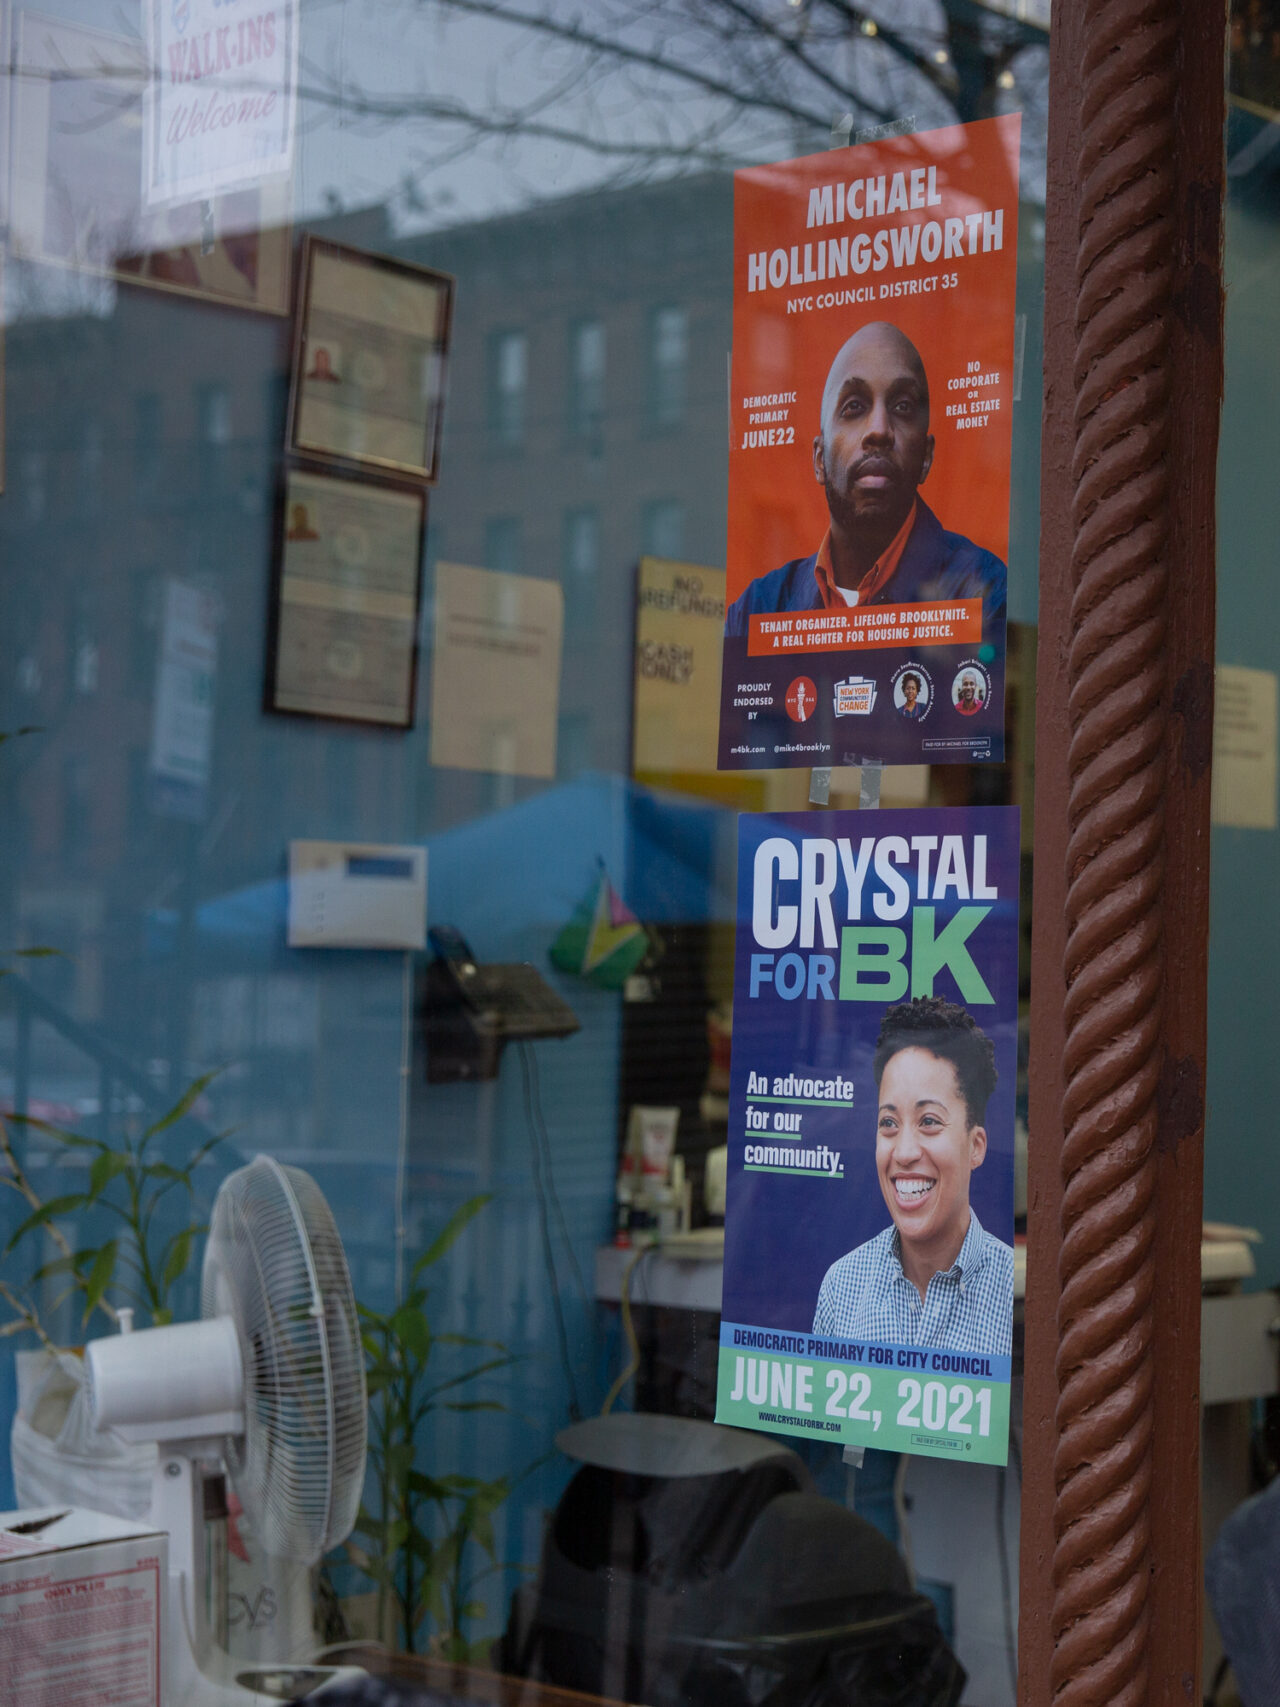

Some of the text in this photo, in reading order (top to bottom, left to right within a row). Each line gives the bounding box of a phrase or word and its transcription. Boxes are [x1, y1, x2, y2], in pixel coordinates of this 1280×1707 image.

[168, 11, 276, 84] WALK-INS
[166, 90, 277, 145] Welcome
[806, 165, 942, 229] MICHAEL
[748, 208, 1004, 293] HOLLINGSWORTH
[787, 273, 959, 314] NYC COUNCIL DISTRICT 35
[967, 361, 980, 373] NO
[947, 373, 1000, 391] CORPORATE
[743, 392, 797, 409] DEMOCRATIC
[967, 390, 979, 399] OR
[749, 410, 789, 424] PRIMARY
[946, 399, 1001, 416] REAL ESTATE
[956, 415, 989, 430] MONEY
[760, 607, 970, 634] TENANT ORGANIZER. LIFELONG BROOKLYNITE.
[773, 624, 955, 648] A REAL FIGHTER FOR HOUSING JUSTICE.
[737, 683, 772, 693] PROUDLY
[733, 697, 774, 707] ENDORSED
[839, 701, 869, 711] CHANGE
[748, 712, 758, 720] BY
[730, 742, 831, 754] m4bk.com @mike4brooklyn
[752, 834, 998, 949] CRYSTAL
[746, 1071, 854, 1100] An advocate
[745, 1105, 802, 1132] for our
[744, 1144, 844, 1176] community.
[734, 1329, 993, 1377] DEMOCRATIC PRIMARY FOR CITY COUNCIL
[730, 1356, 992, 1437] JUNE 22, 2021
[758, 1411, 842, 1433] WWW.CRYSTALFORBK.COM
